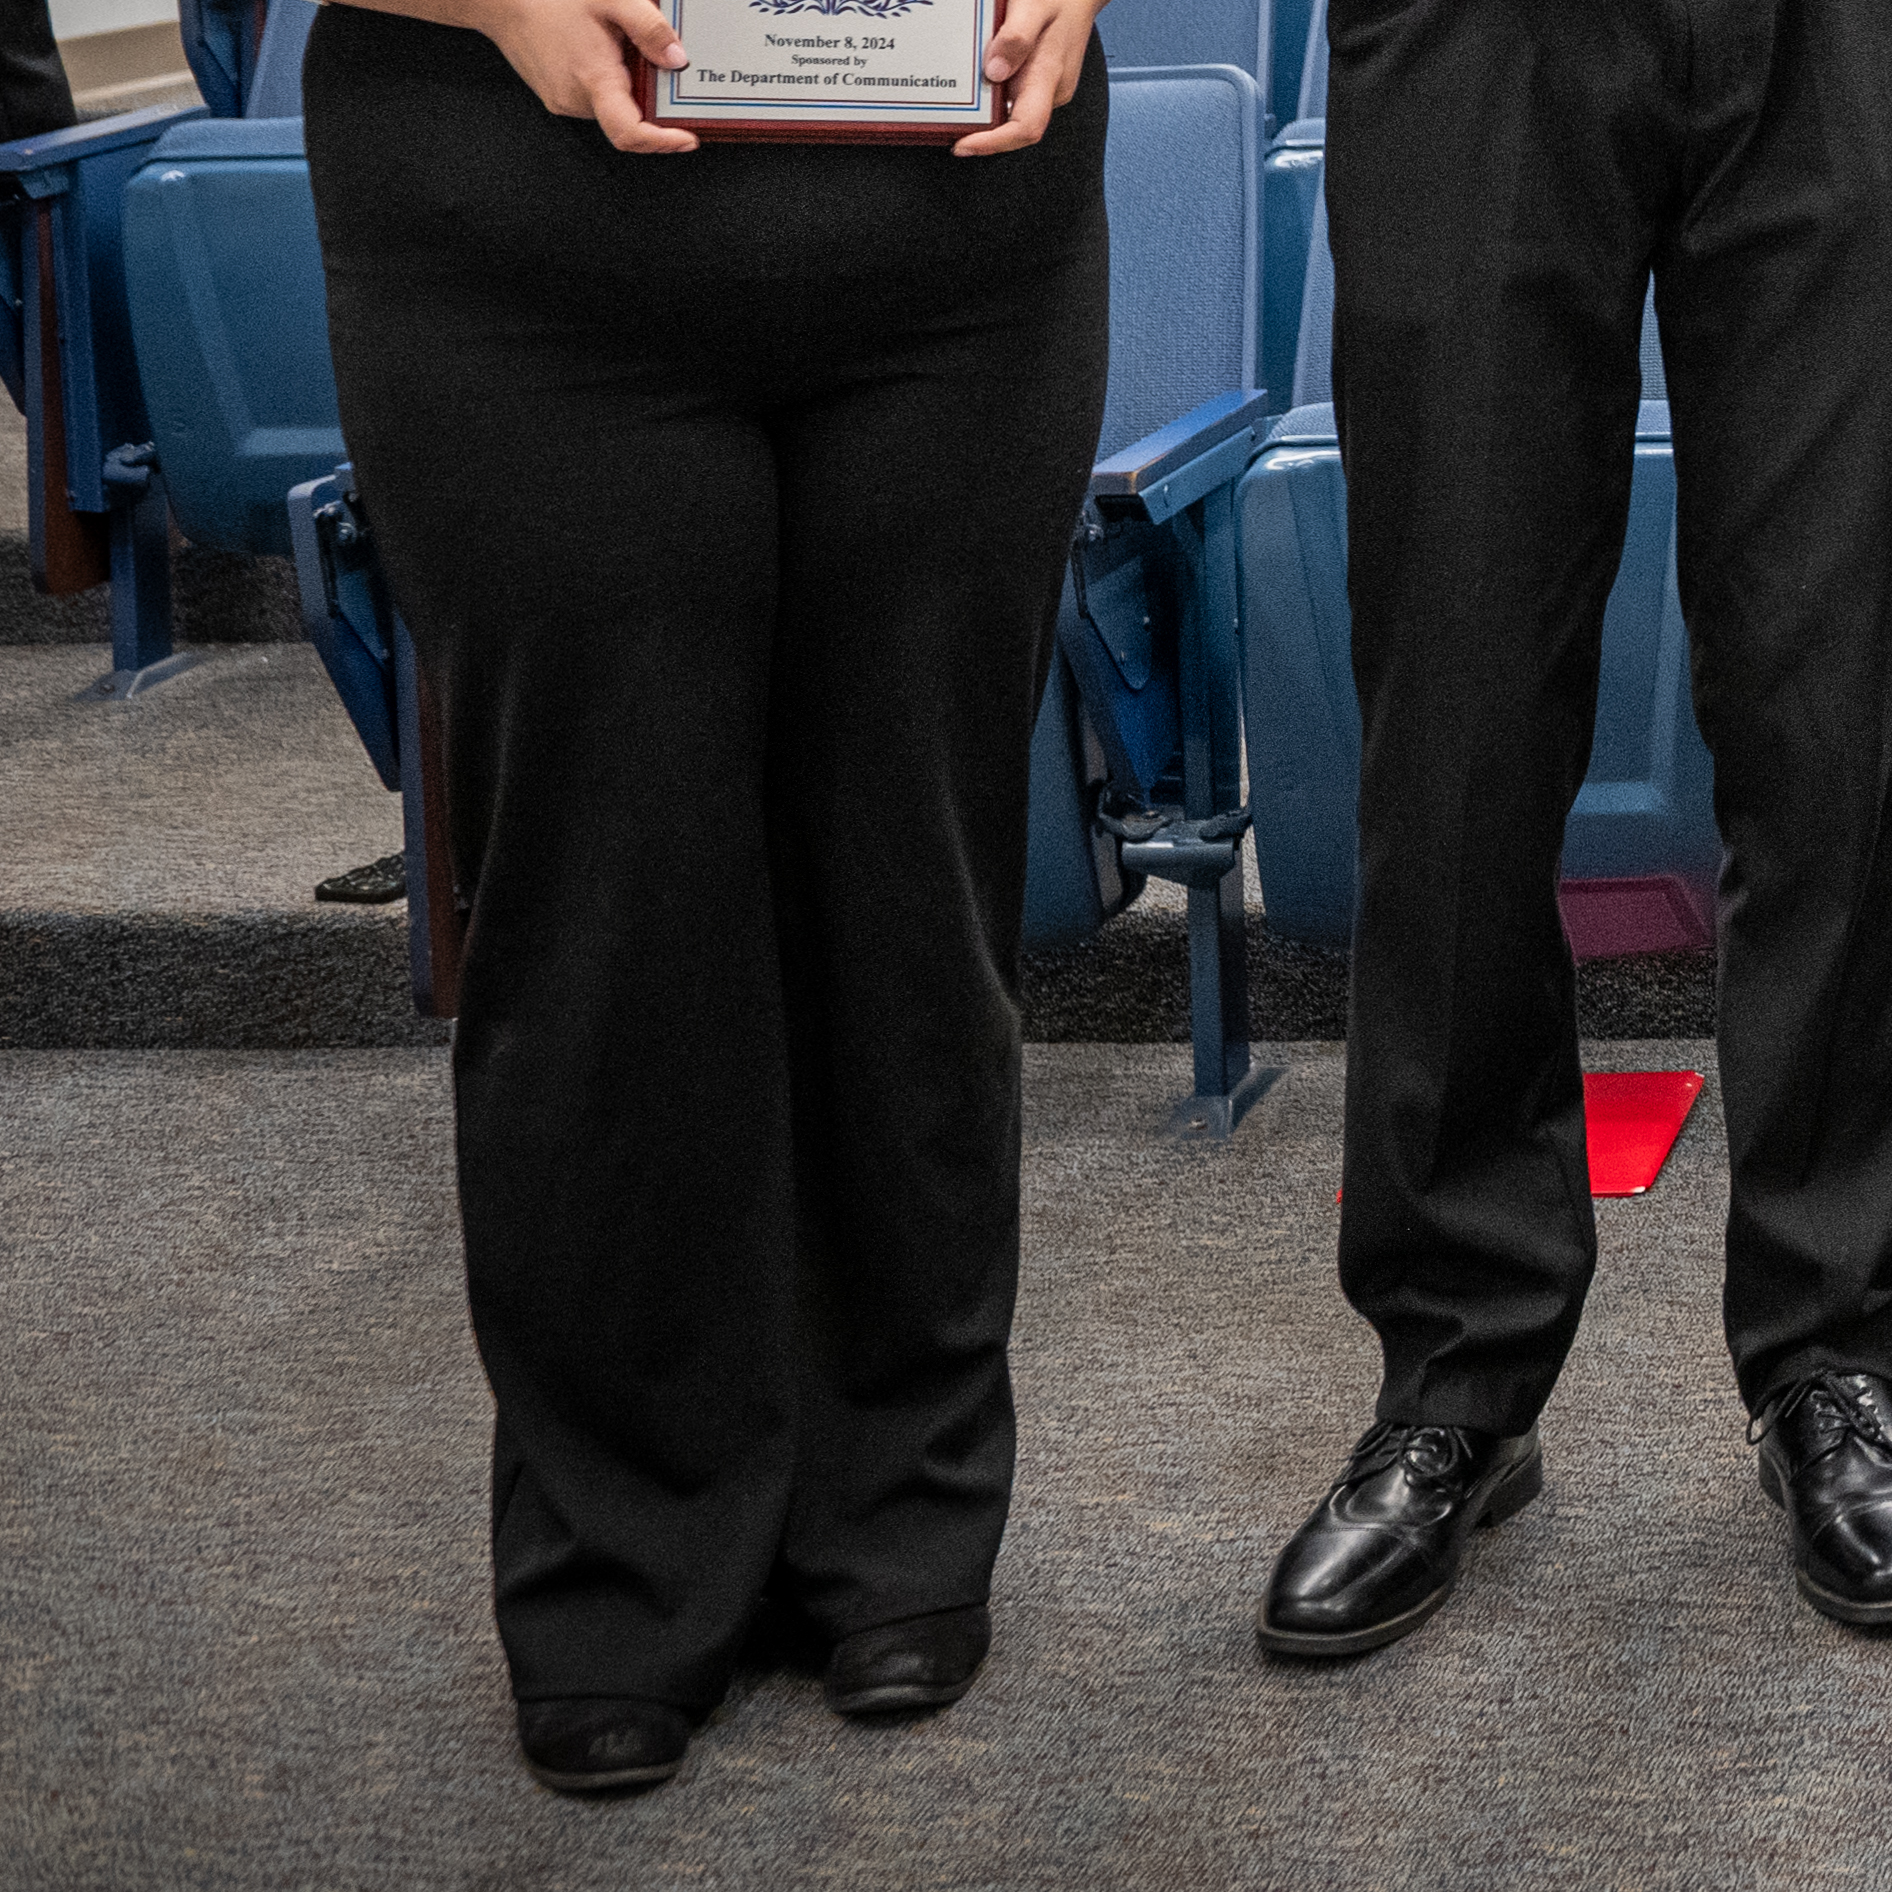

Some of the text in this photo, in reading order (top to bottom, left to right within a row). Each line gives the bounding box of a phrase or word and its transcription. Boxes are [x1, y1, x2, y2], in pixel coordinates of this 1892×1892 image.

[765, 33, 896, 50] November 8, 2024
[791, 54, 868, 69] Sponsored by
[696, 68, 957, 88] The Department of Communication
